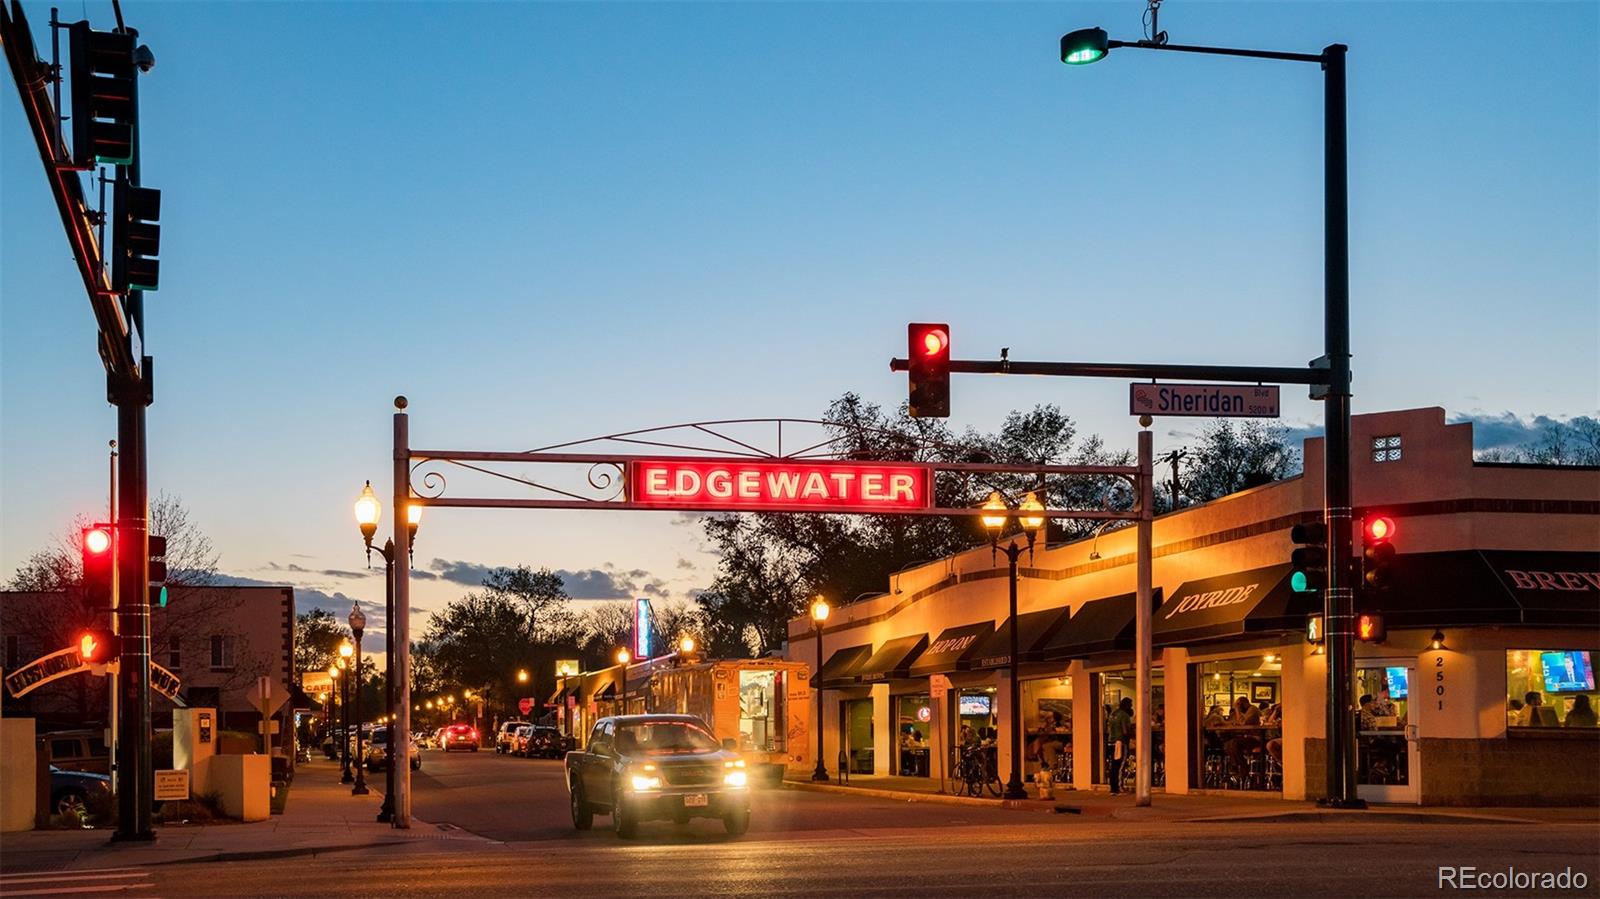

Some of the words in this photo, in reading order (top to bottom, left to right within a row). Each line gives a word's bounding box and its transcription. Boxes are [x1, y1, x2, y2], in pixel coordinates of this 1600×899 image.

[1158, 388, 1244, 412] Sheridan
[1254, 388, 1269, 399] Blvd
[1248, 405, 1267, 414] 5200
[645, 468, 915, 501] EDGEWATER
[1164, 583, 1260, 620] JOYRIDE
[926, 638, 957, 656] HOP
[950, 634, 977, 651] ON
[1435, 656, 1445, 711] 2501
